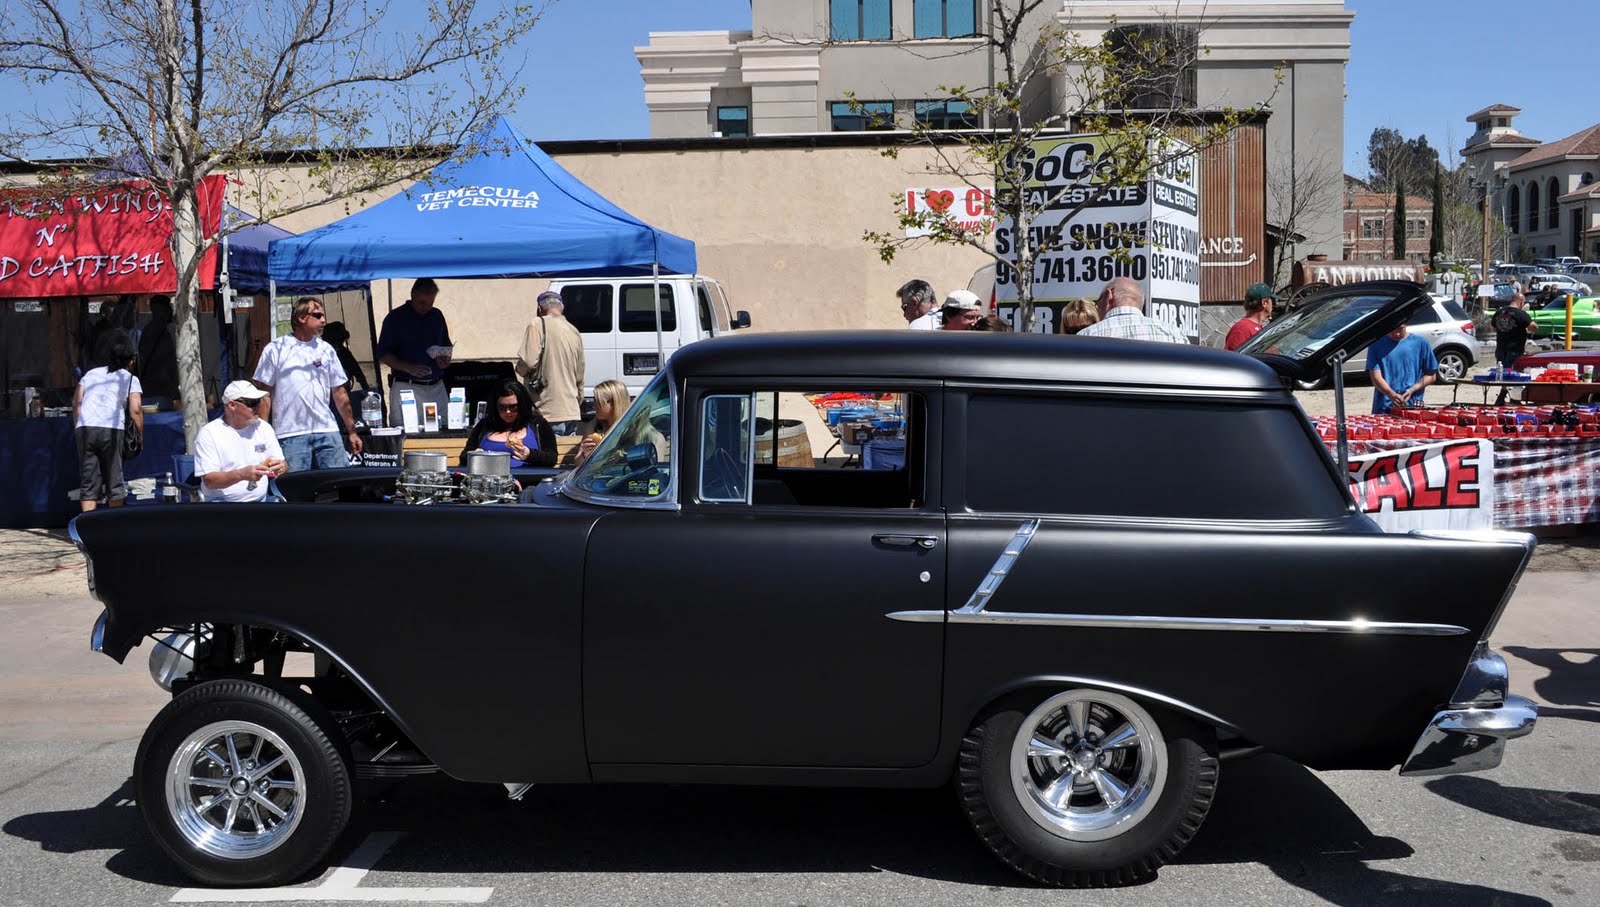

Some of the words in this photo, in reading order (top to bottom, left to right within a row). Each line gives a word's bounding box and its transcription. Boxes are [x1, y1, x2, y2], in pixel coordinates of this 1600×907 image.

[1004, 143, 1128, 184] SoCa
[77, 188, 173, 223] WING
[416, 200, 454, 212] VET
[457, 197, 539, 209] CENTER
[420, 186, 540, 202] TEMECULA
[1060, 185, 1138, 204] ESTATE
[1155, 183, 1174, 204] REAL
[1174, 190, 1197, 211] ESTATE
[35, 223, 67, 247] N'
[1070, 222, 1147, 251] SNOW
[1152, 219, 1179, 251] STEVE
[1180, 226, 1198, 257] SNOW
[28, 252, 164, 278] CATFISH
[996, 255, 1147, 285] 9.741.3600
[1151, 252, 1199, 286] 951.741.3600
[1152, 302, 1180, 331] FOR
[363, 452, 399, 460] Department
